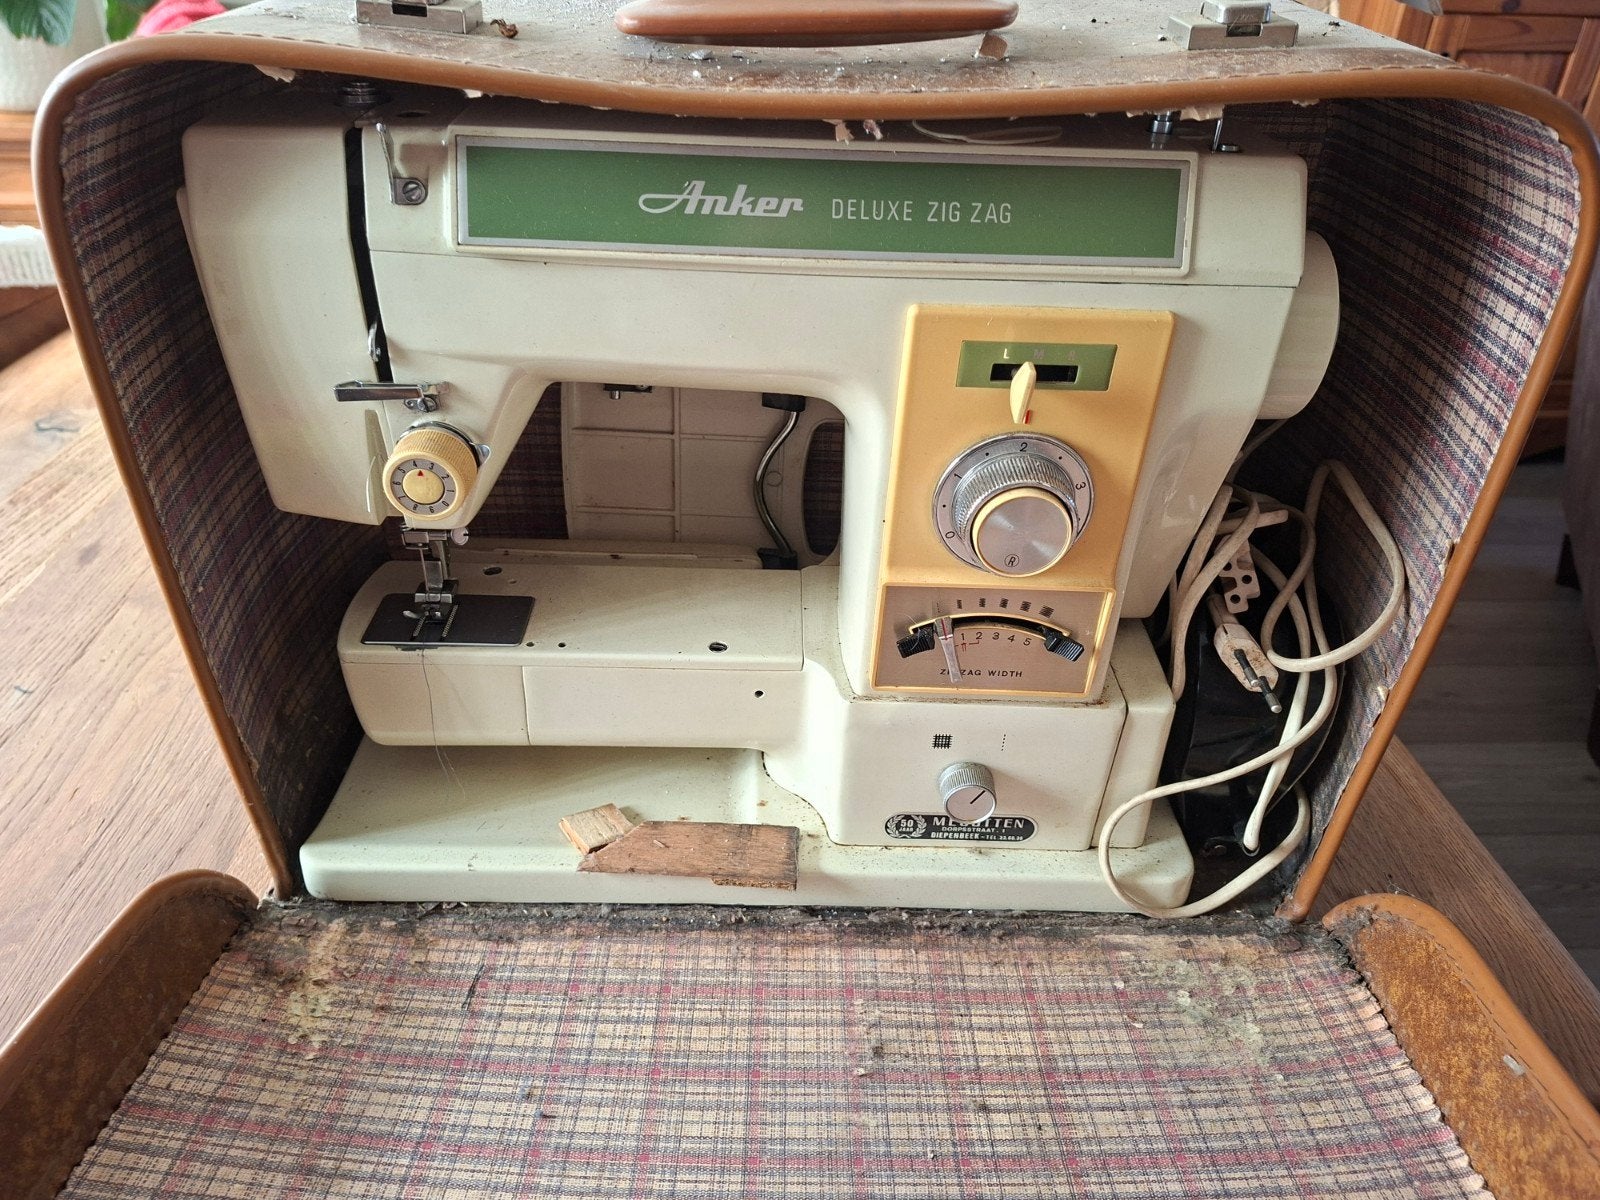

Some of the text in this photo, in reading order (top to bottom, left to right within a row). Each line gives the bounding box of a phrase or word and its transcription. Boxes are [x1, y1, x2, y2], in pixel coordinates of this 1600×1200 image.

[638, 180, 1012, 224] Anker DELUXE ZIG ZAG
[1003, 348, 1010, 359] L
[428, 462, 434, 470] 3
[944, 531, 956, 539] 0
[1019, 442, 1028, 453] 2
[1075, 481, 1086, 491] 3
[960, 631, 1032, 646] 1 2 3 4 5
[987, 669, 1023, 678] WIDTH
[900, 819, 914, 827] 50
